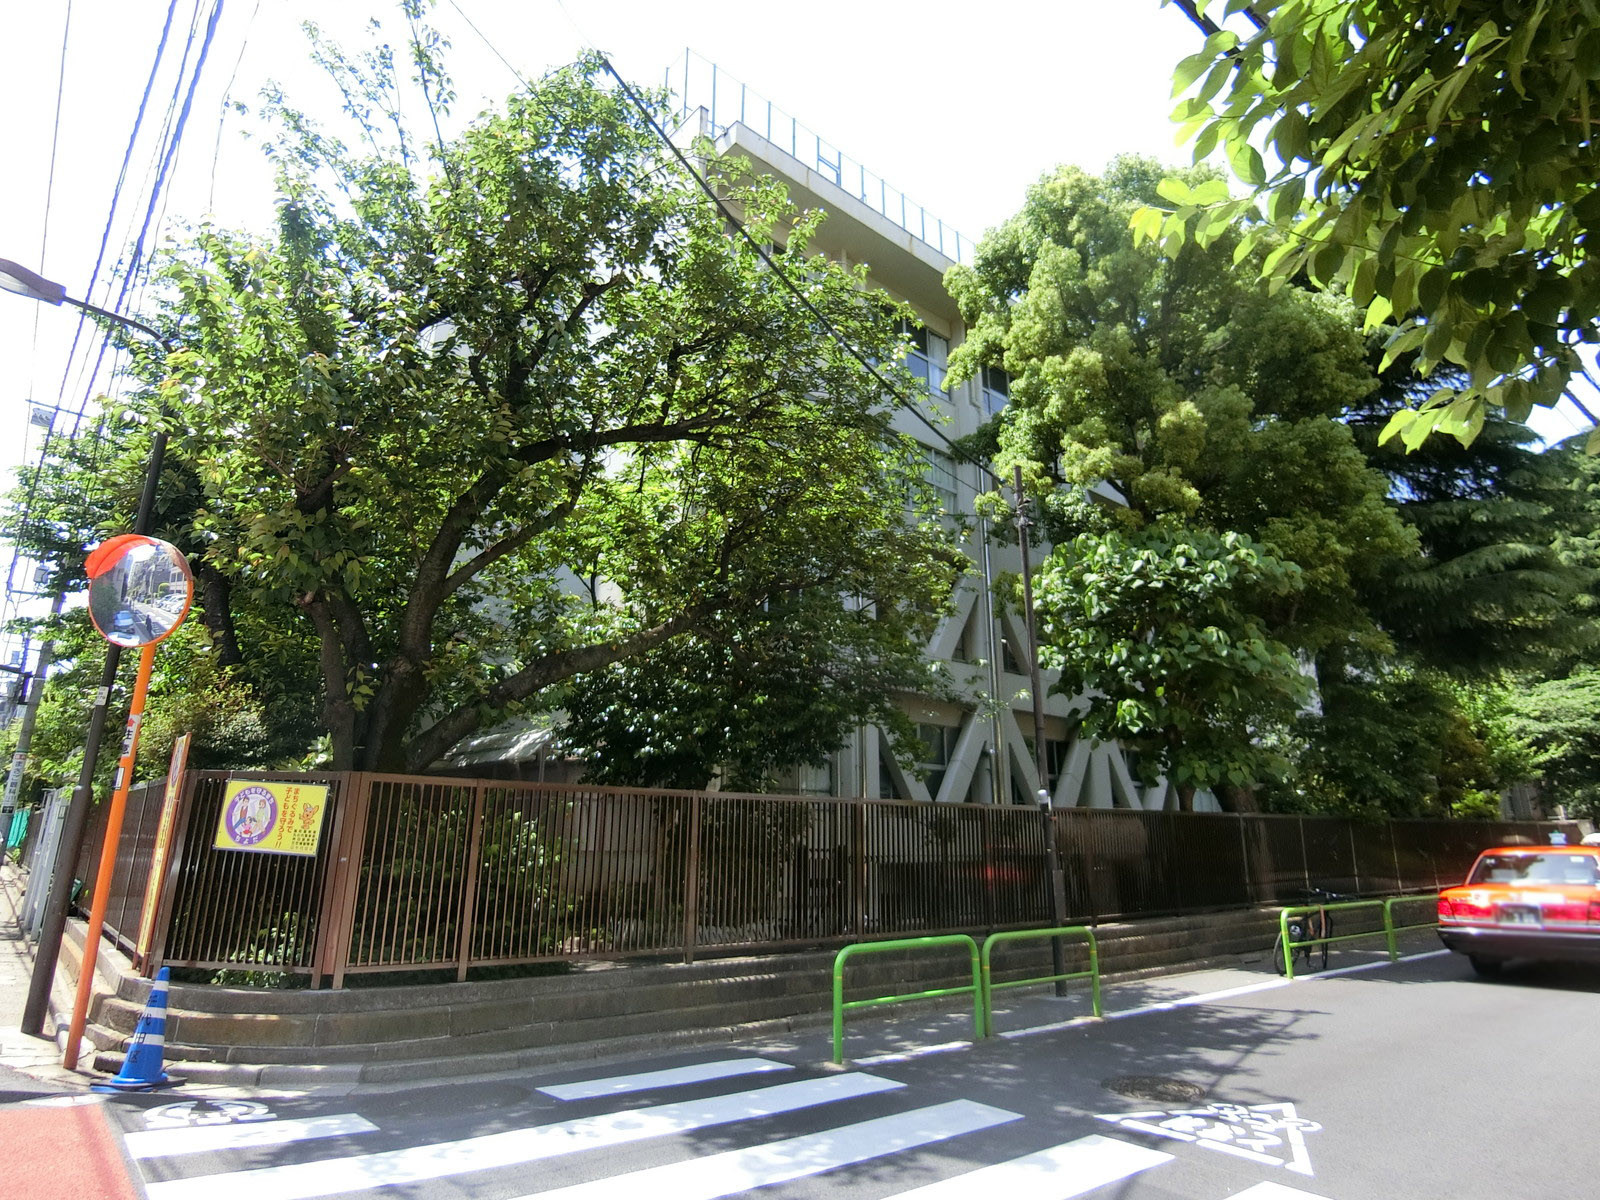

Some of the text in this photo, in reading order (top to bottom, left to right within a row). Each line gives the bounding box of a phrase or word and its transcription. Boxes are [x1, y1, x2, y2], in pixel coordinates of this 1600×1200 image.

[286, 787, 300, 833] まちぐるみで
